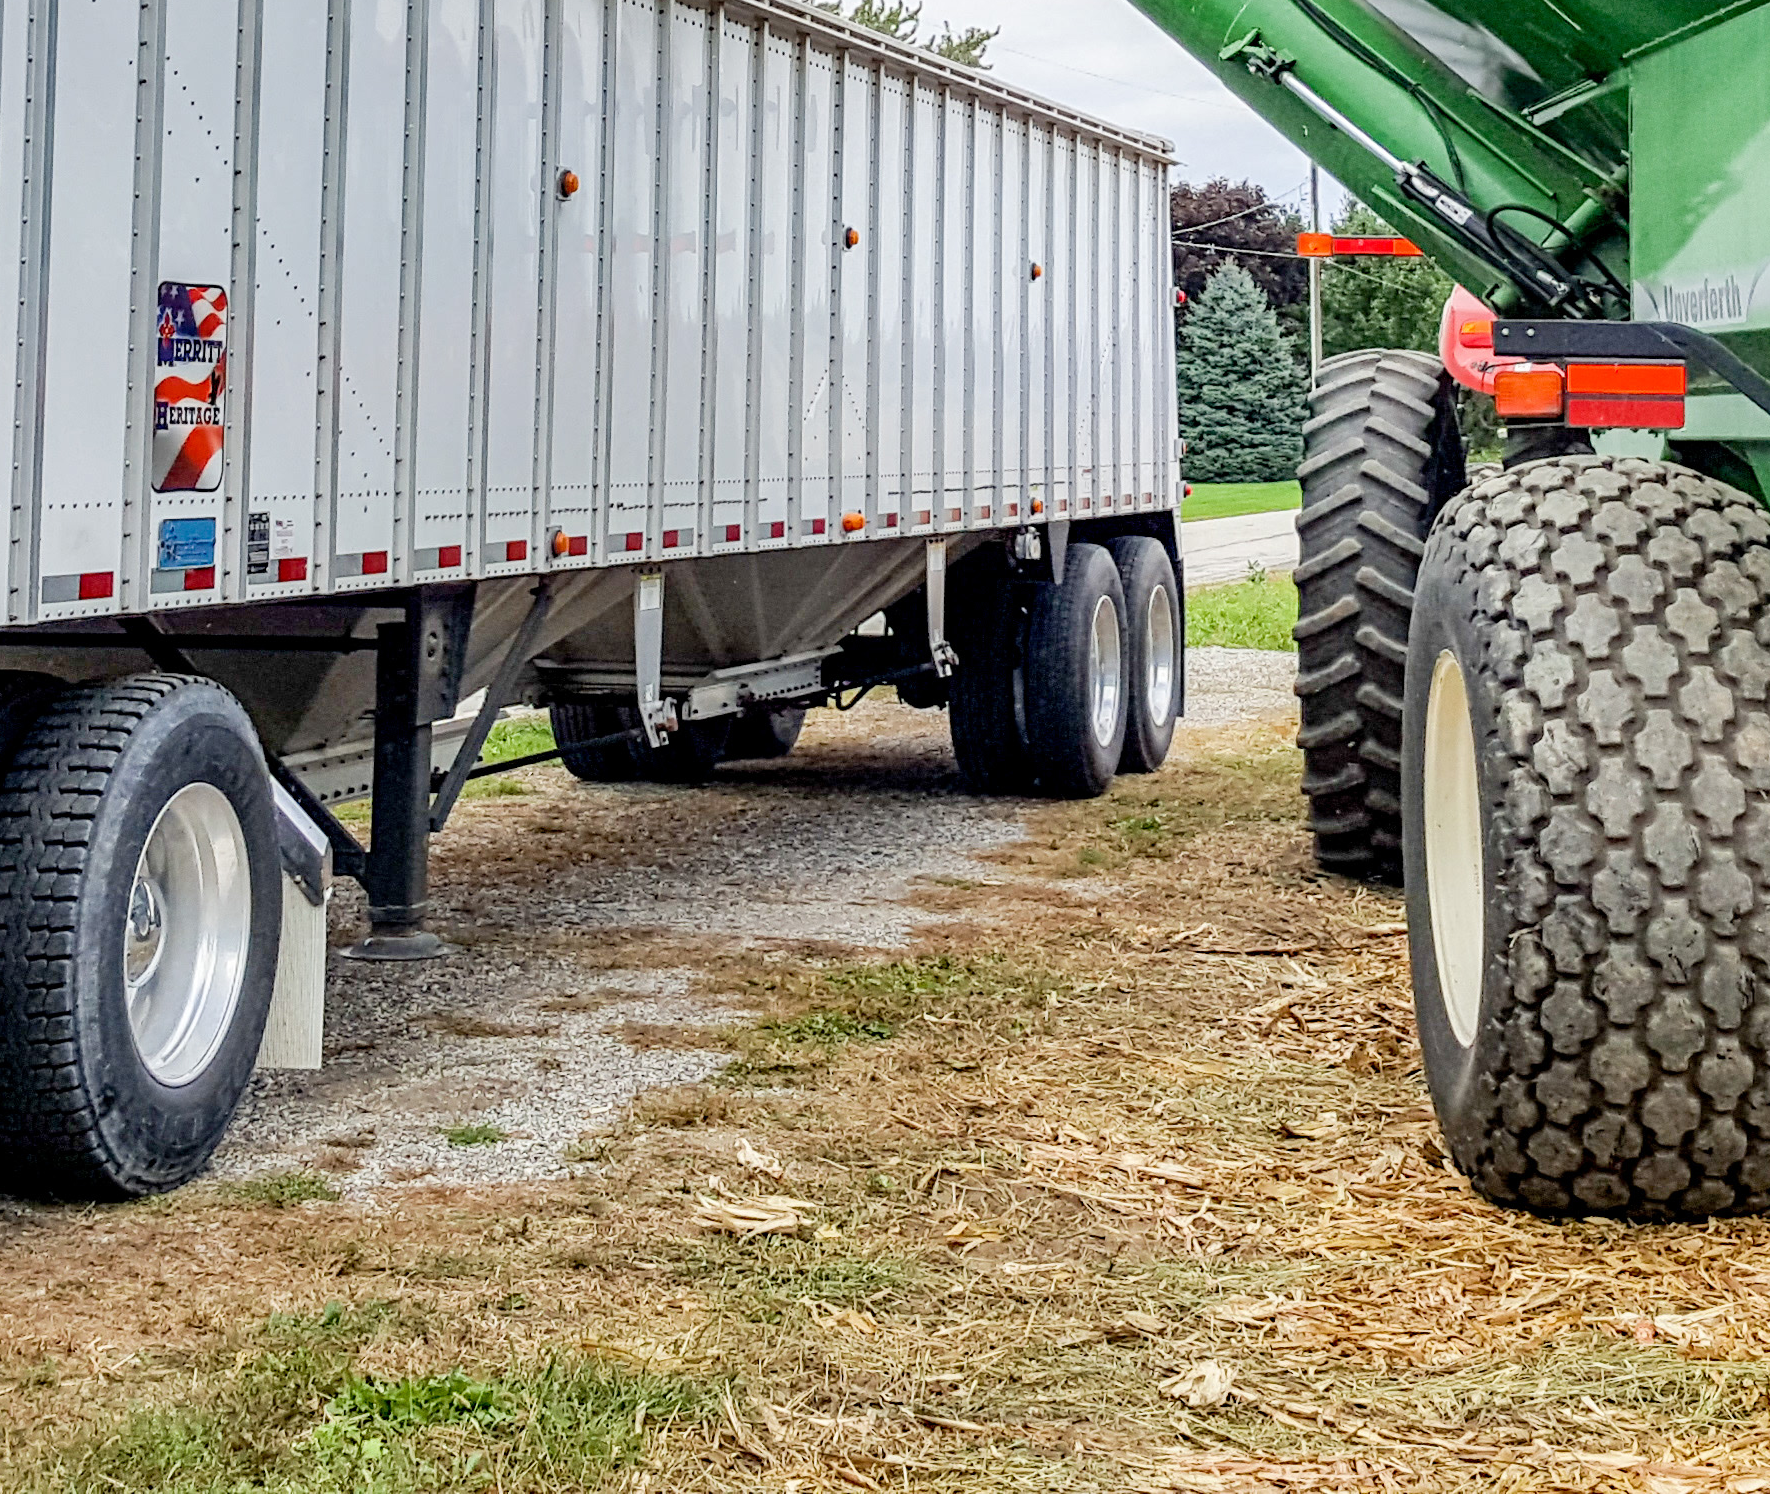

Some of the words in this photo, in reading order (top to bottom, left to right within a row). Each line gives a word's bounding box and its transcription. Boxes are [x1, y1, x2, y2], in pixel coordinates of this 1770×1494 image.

[1663, 274, 1742, 323] Unverferth
[157, 338, 223, 367] MERRITT
[156, 402, 220, 430] HERITAGE
